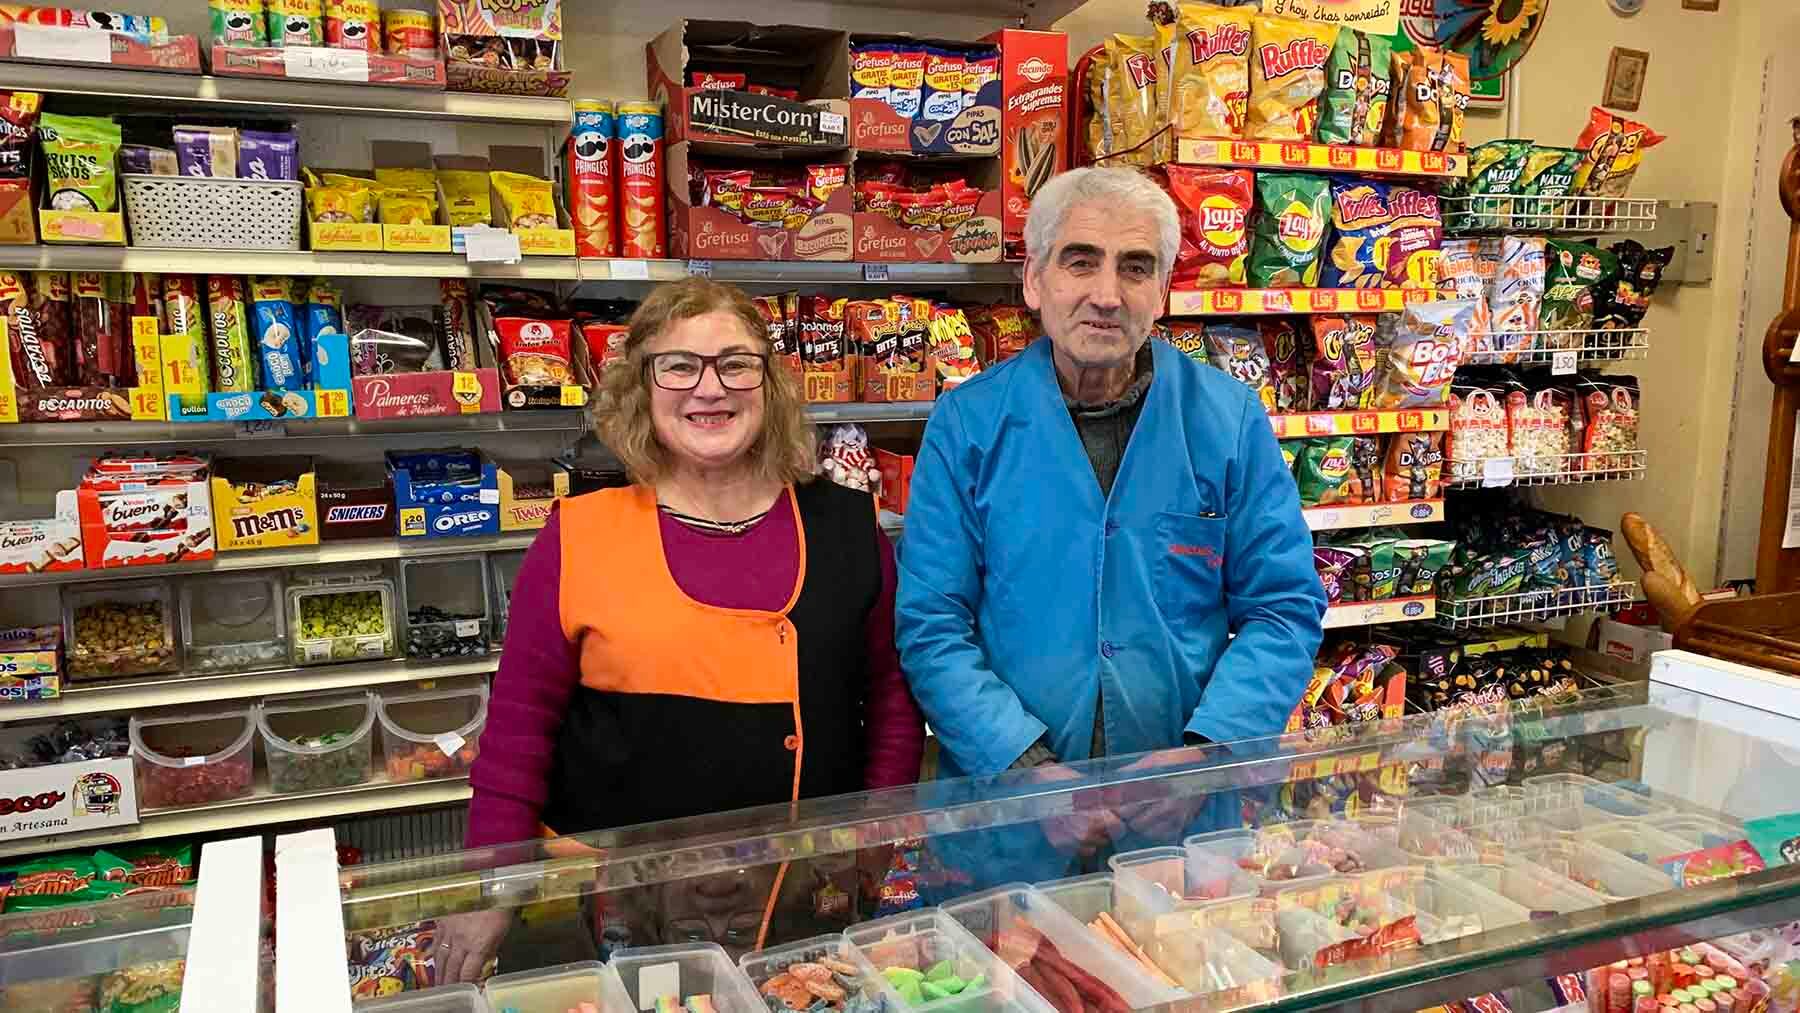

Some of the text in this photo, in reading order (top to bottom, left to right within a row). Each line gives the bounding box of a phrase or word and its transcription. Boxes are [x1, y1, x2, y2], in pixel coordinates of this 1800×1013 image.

[1187, 24, 1250, 64] Ruffles
[855, 57, 890, 69] Grefusa
[892, 58, 922, 69] refusa
[928, 61, 962, 74] Grefusa
[963, 62, 993, 74] refusa
[1008, 83, 1063, 110] Extragrandes
[1021, 94, 1062, 115] Supremas
[692, 96, 813, 128] MisterCorn
[966, 110, 985, 119] PIPAS
[856, 123, 905, 138] Grefusa
[970, 120, 998, 144] SAL
[575, 160, 608, 176] PRINGLES
[624, 161, 656, 178] PRINGLES
[1388, 190, 1438, 220] uffles
[695, 231, 749, 249] Grefusa
[858, 235, 906, 253] Grefusa
[365, 379, 430, 408] Palmeras
[38, 396, 112, 412] BOCADITOS
[181, 406, 207, 415] gullón
[112, 503, 160, 522] bueno
[328, 505, 387, 522] SNICKERS
[435, 510, 491, 532] OREO
[1, 532, 45, 550] bueno
[11, 817, 68, 833] Artesana
